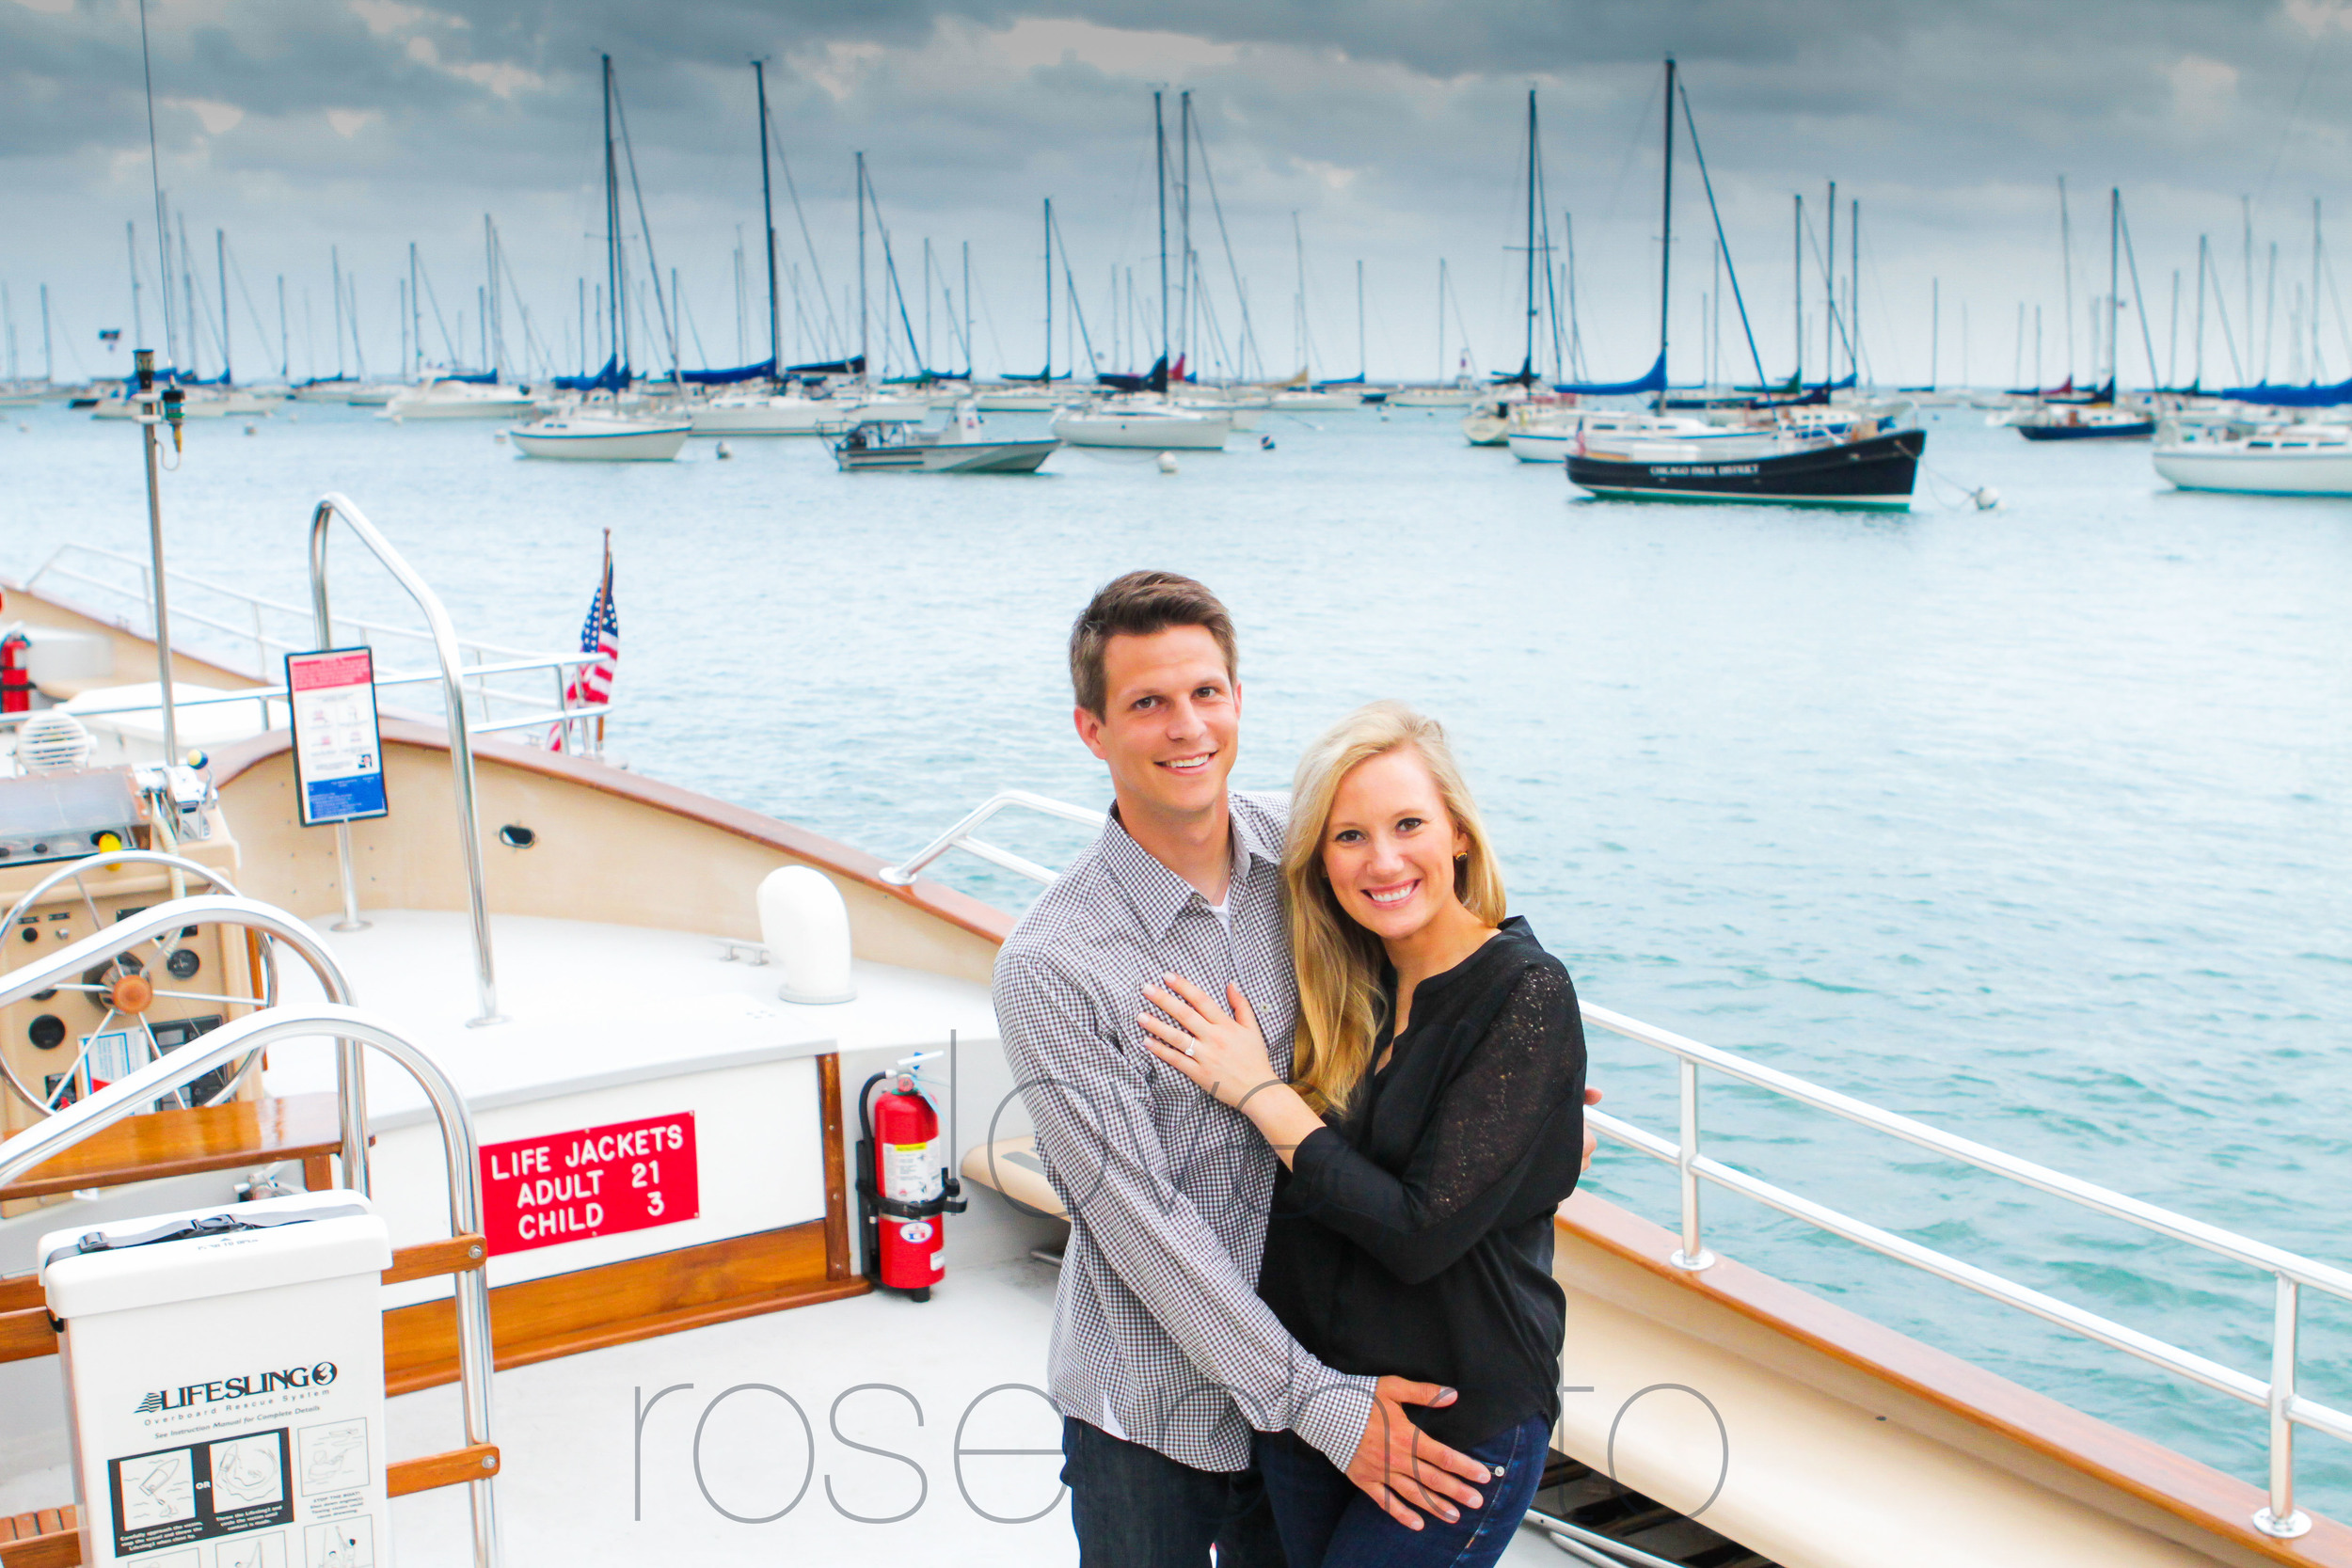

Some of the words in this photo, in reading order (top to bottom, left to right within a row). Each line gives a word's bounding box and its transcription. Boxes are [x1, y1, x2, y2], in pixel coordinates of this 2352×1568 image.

[1649, 465, 1689, 475] CHICAGO
[1691, 465, 1716, 475] PARK
[1718, 463, 1759, 475] DISTRICT
[491, 1146, 551, 1180] LIFE
[564, 1124, 683, 1168] JACKETS
[516, 1169, 604, 1209] ADULT
[631, 1160, 660, 1188] 21
[517, 1202, 604, 1240] CHILD
[646, 1191, 664, 1216] 3
[144, 1407, 216, 1426] Overboard
[226, 1399, 273, 1411] Rescue
[282, 1389, 329, 1402] System
[170, 1424, 211, 1436] Instruction
[213, 1418, 242, 1428] Manual
[244, 1416, 255, 1424] for
[256, 1411, 293, 1421] Complete
[294, 1405, 321, 1415] Details
[195, 1481, 212, 1490] OR
